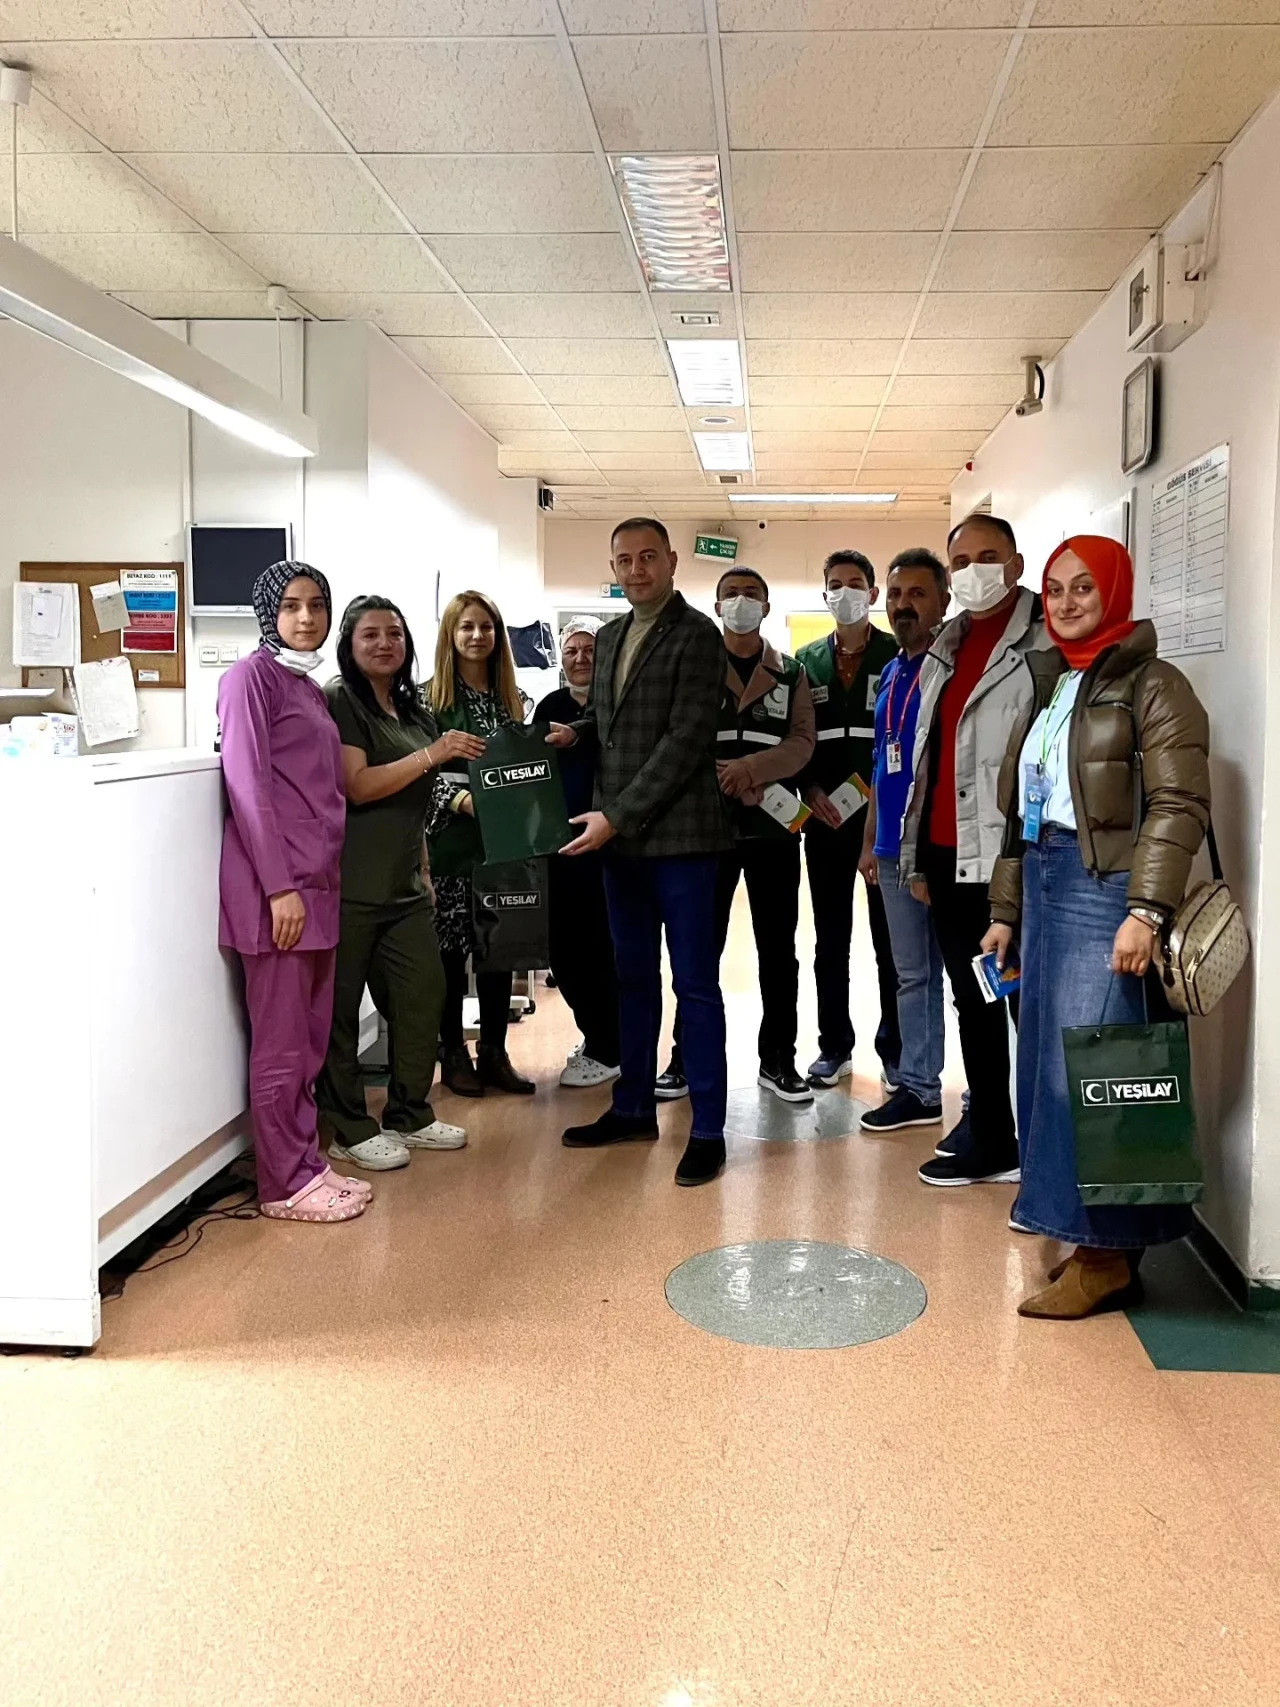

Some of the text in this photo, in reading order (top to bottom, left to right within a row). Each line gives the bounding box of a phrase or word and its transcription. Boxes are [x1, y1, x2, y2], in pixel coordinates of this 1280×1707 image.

[503, 764, 546, 781] YEŞİLAY
[500, 894, 537, 906] YEŞİLAY
[1112, 1082, 1173, 1099] YEŞİLAY
